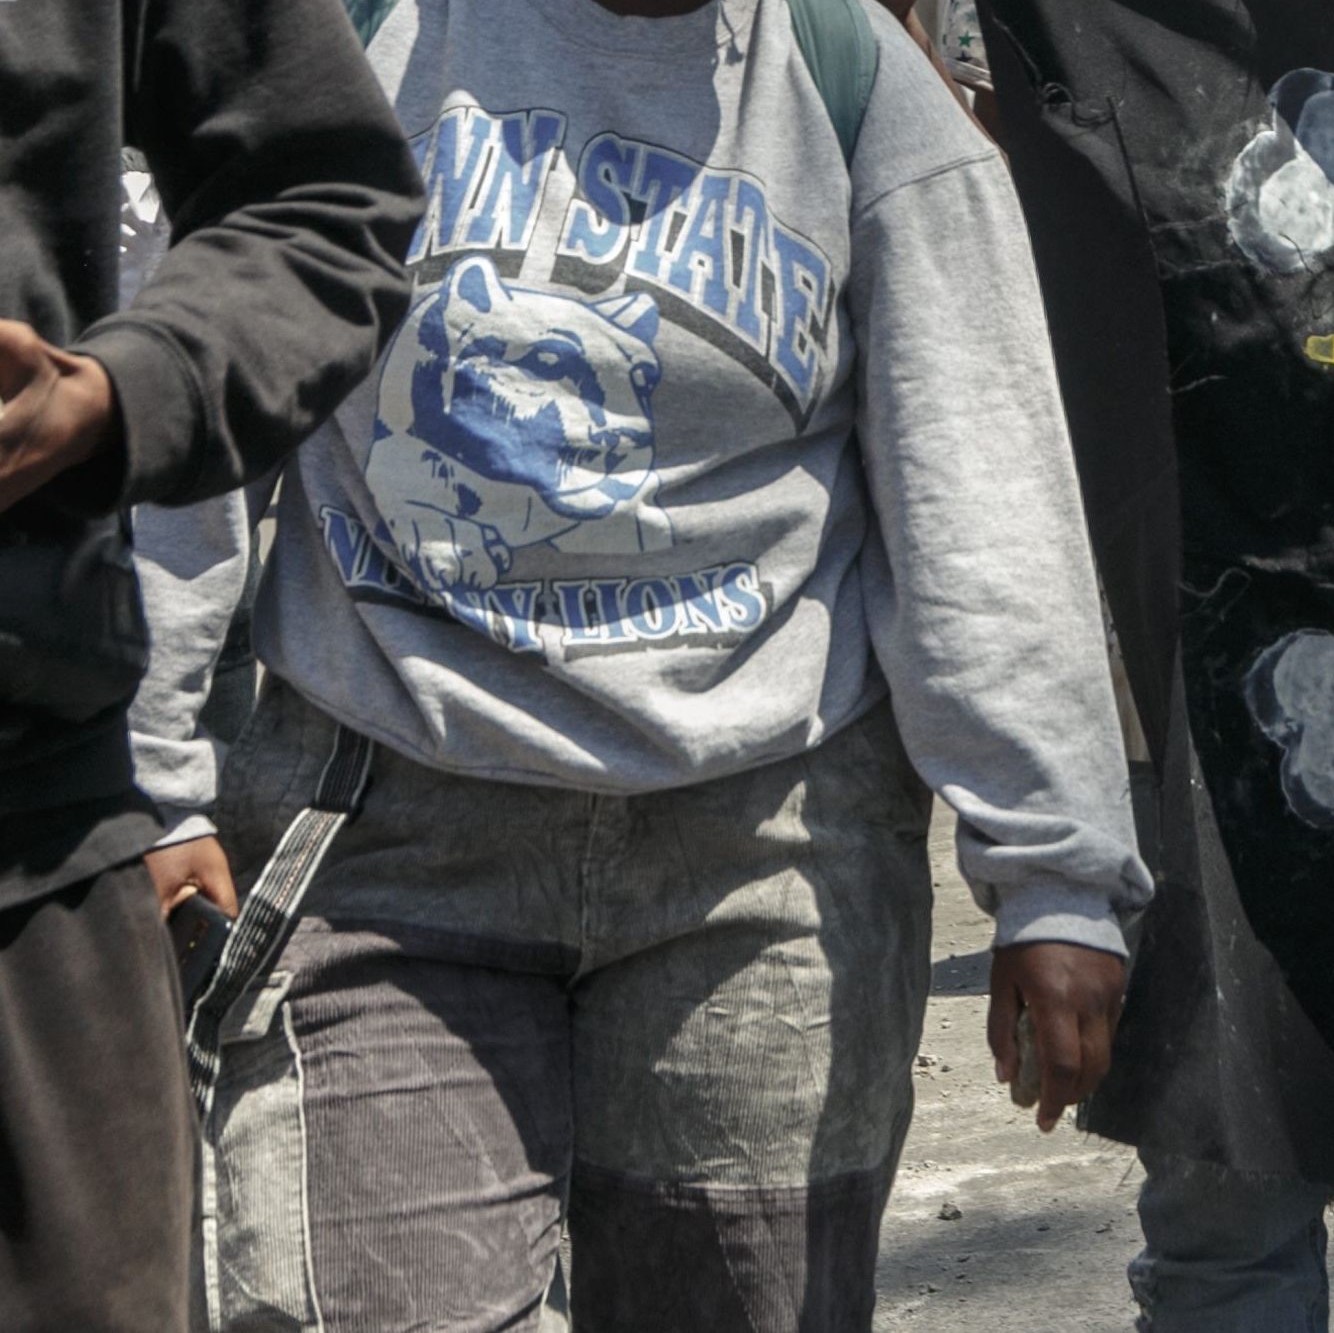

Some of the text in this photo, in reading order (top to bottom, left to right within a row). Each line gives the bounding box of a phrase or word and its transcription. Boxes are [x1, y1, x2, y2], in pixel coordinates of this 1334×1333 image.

[404, 107, 839, 404] NN STATE
[553, 562, 770, 650] LIONS
